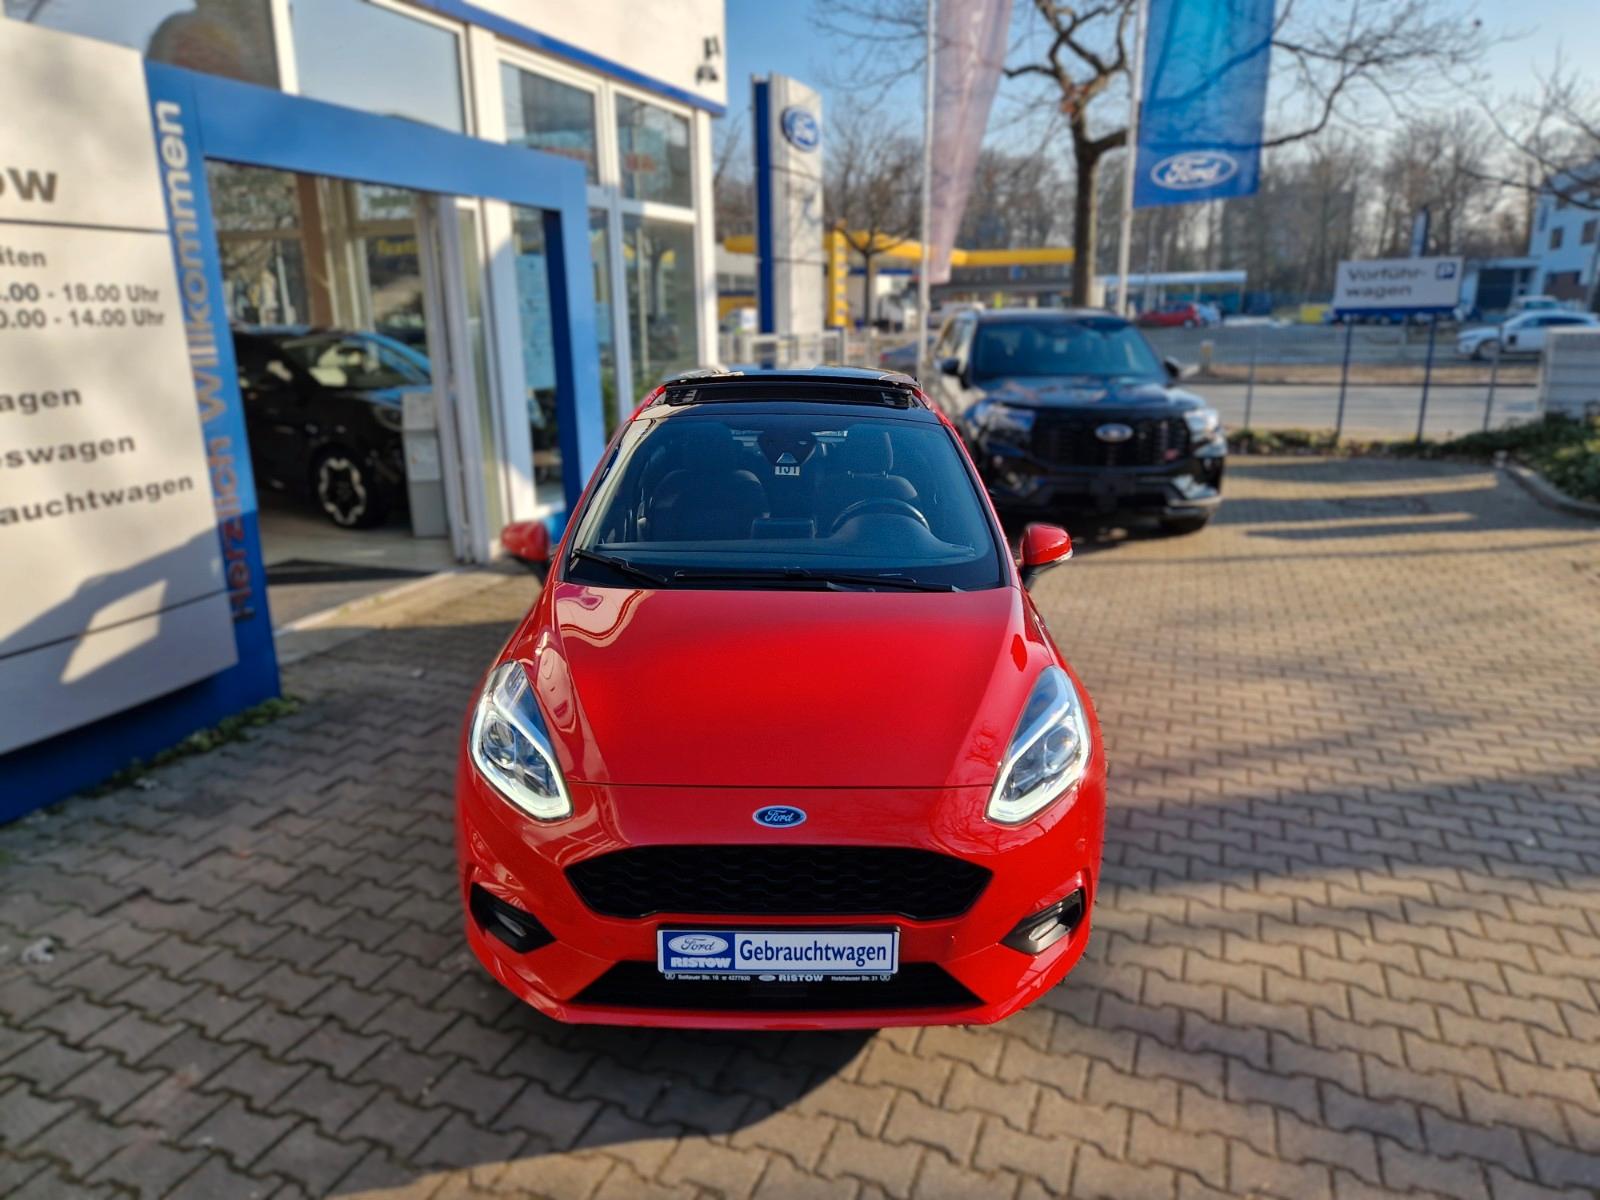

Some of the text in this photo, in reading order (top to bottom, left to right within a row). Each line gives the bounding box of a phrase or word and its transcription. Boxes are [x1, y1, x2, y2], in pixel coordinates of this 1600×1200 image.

[156, 100, 226, 425] Willkommen
[0, 283, 40, 303] .00
[64, 283, 121, 303] 18.00
[126, 284, 159, 303] Uhr
[69, 308, 126, 328] 14.00
[131, 308, 164, 327] Uhr
[0, 435, 136, 468] swagen
[764, 810, 794, 821] Ford
[681, 938, 715, 951] Ford
[740, 939, 887, 967] Gebrauchtwagen
[670, 956, 732, 969] RISTOW
[778, 974, 824, 982] RISTOW
